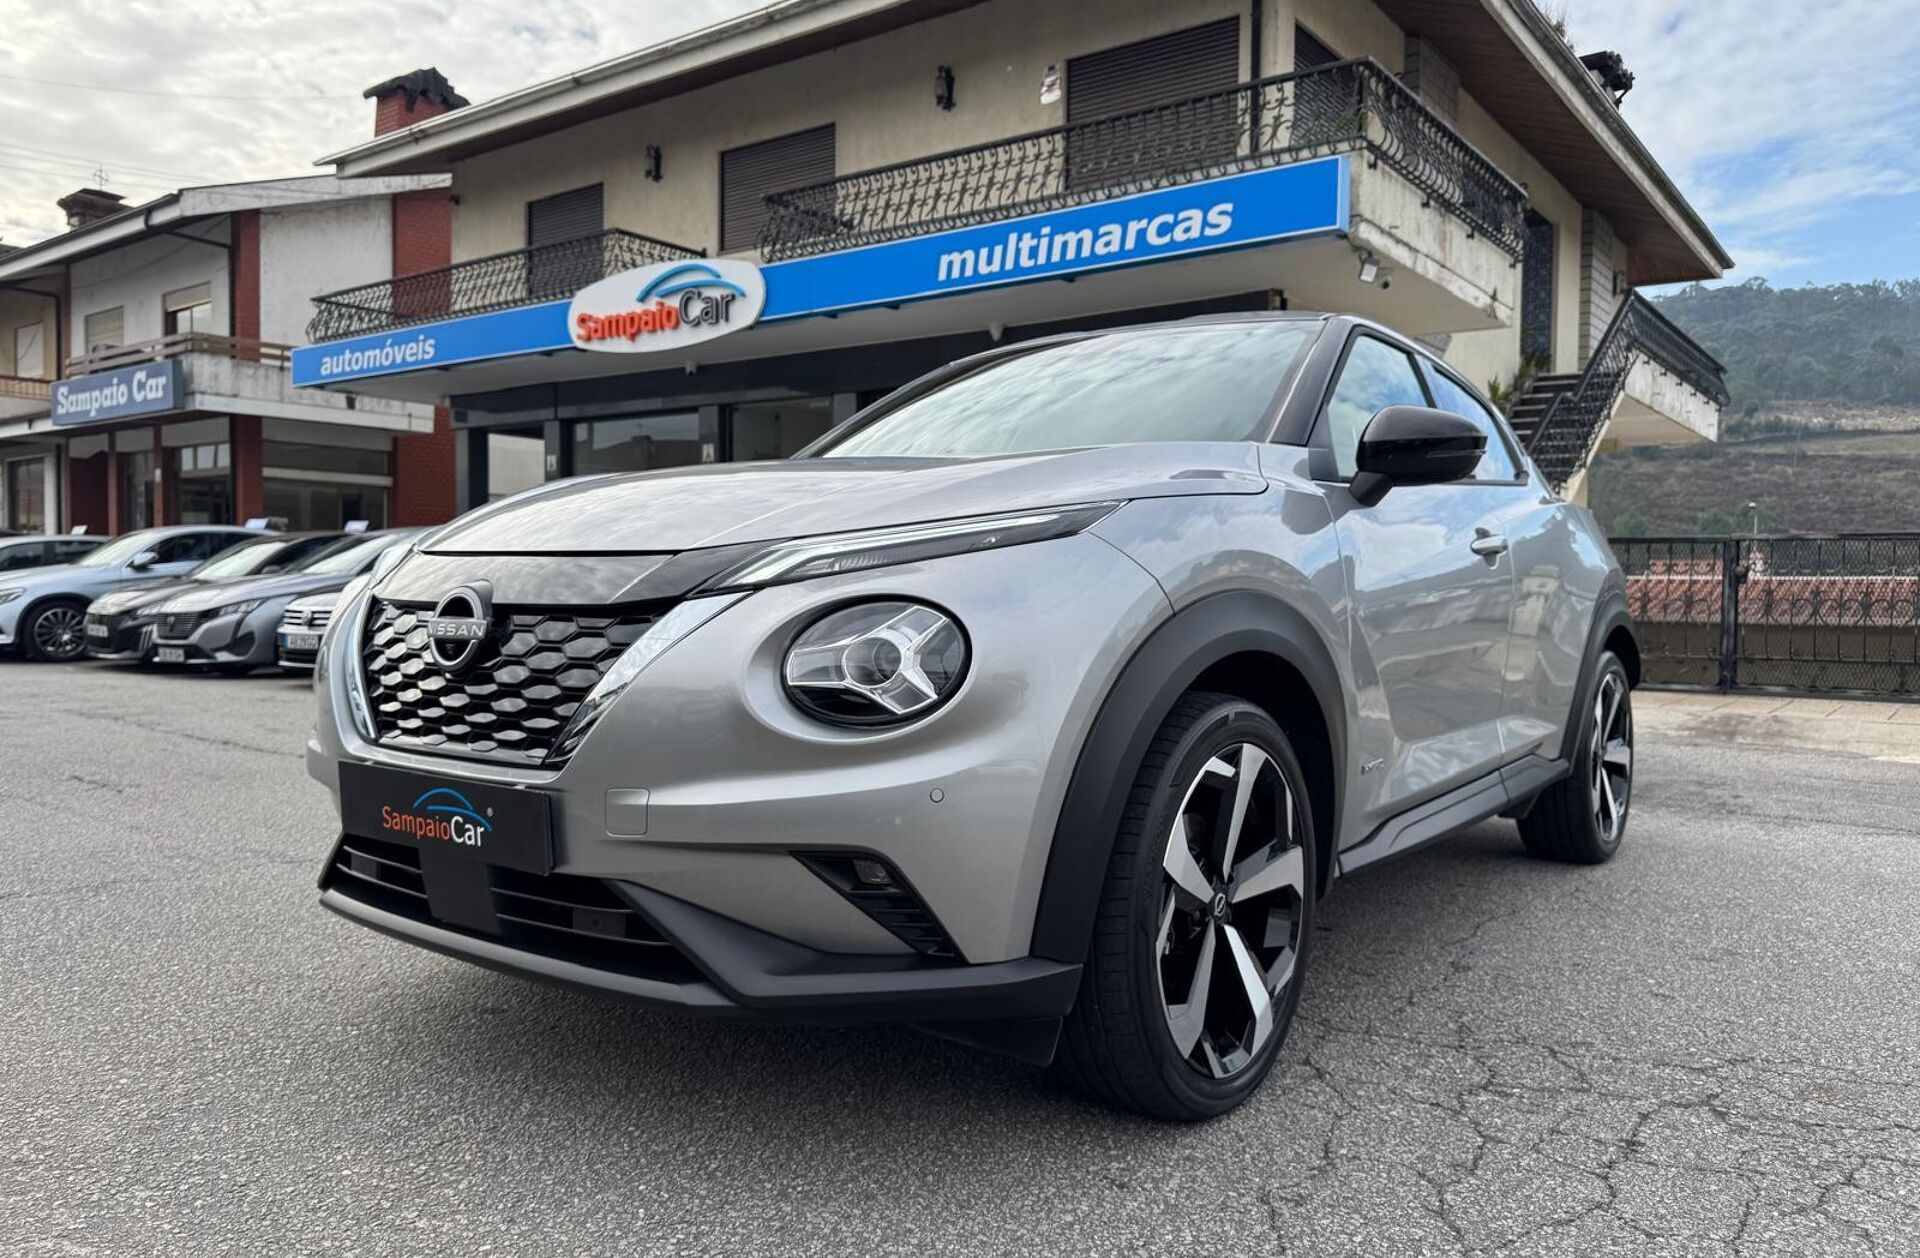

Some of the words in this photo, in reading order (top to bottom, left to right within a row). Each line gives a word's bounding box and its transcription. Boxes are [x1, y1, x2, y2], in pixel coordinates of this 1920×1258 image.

[938, 203, 1234, 282] multimarcas
[320, 334, 436, 376] automóveis
[57, 377, 128, 417] Sampaio
[133, 370, 167, 402] Car
